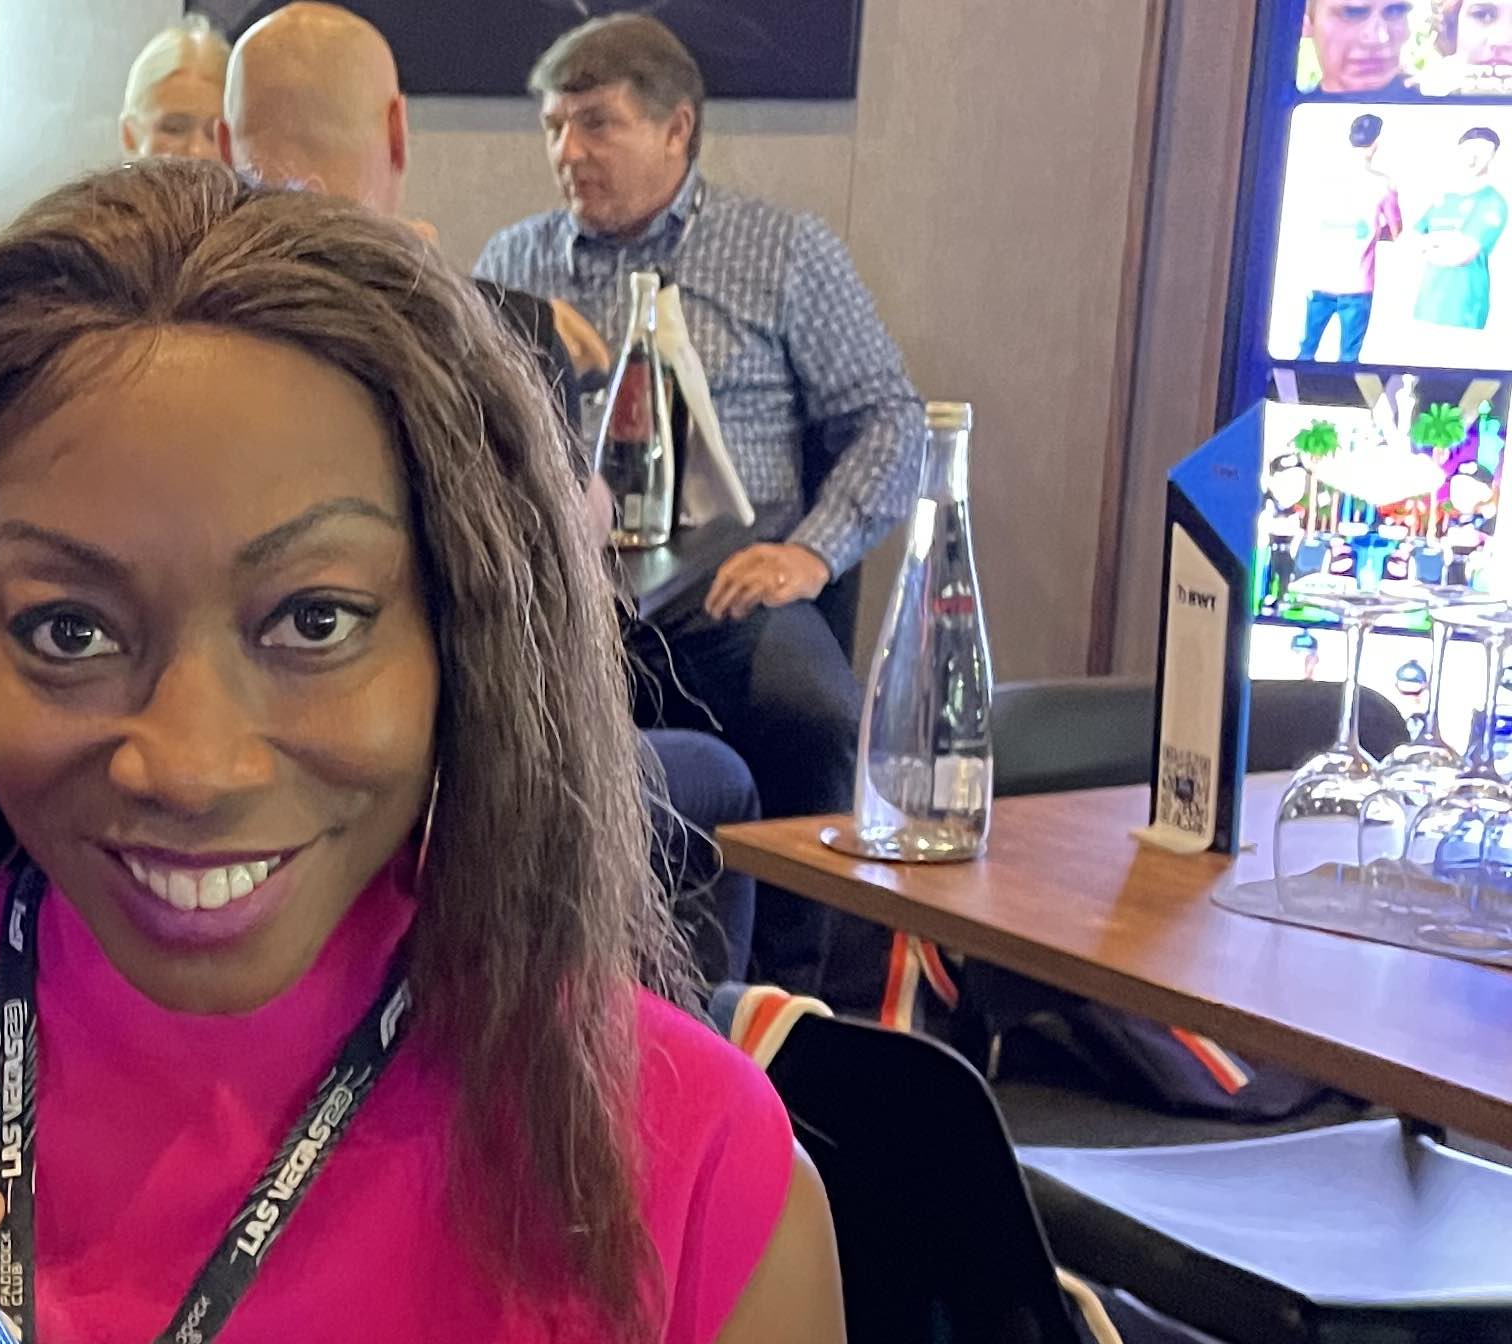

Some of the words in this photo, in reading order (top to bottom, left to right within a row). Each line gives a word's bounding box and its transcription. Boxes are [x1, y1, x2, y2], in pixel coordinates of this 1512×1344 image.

[1, 1123, 23, 1179] LAS
[237, 1199, 280, 1256] LAS
[0, 1229, 12, 1307] PADDOCK
[11, 1262, 23, 1307] CLUB
